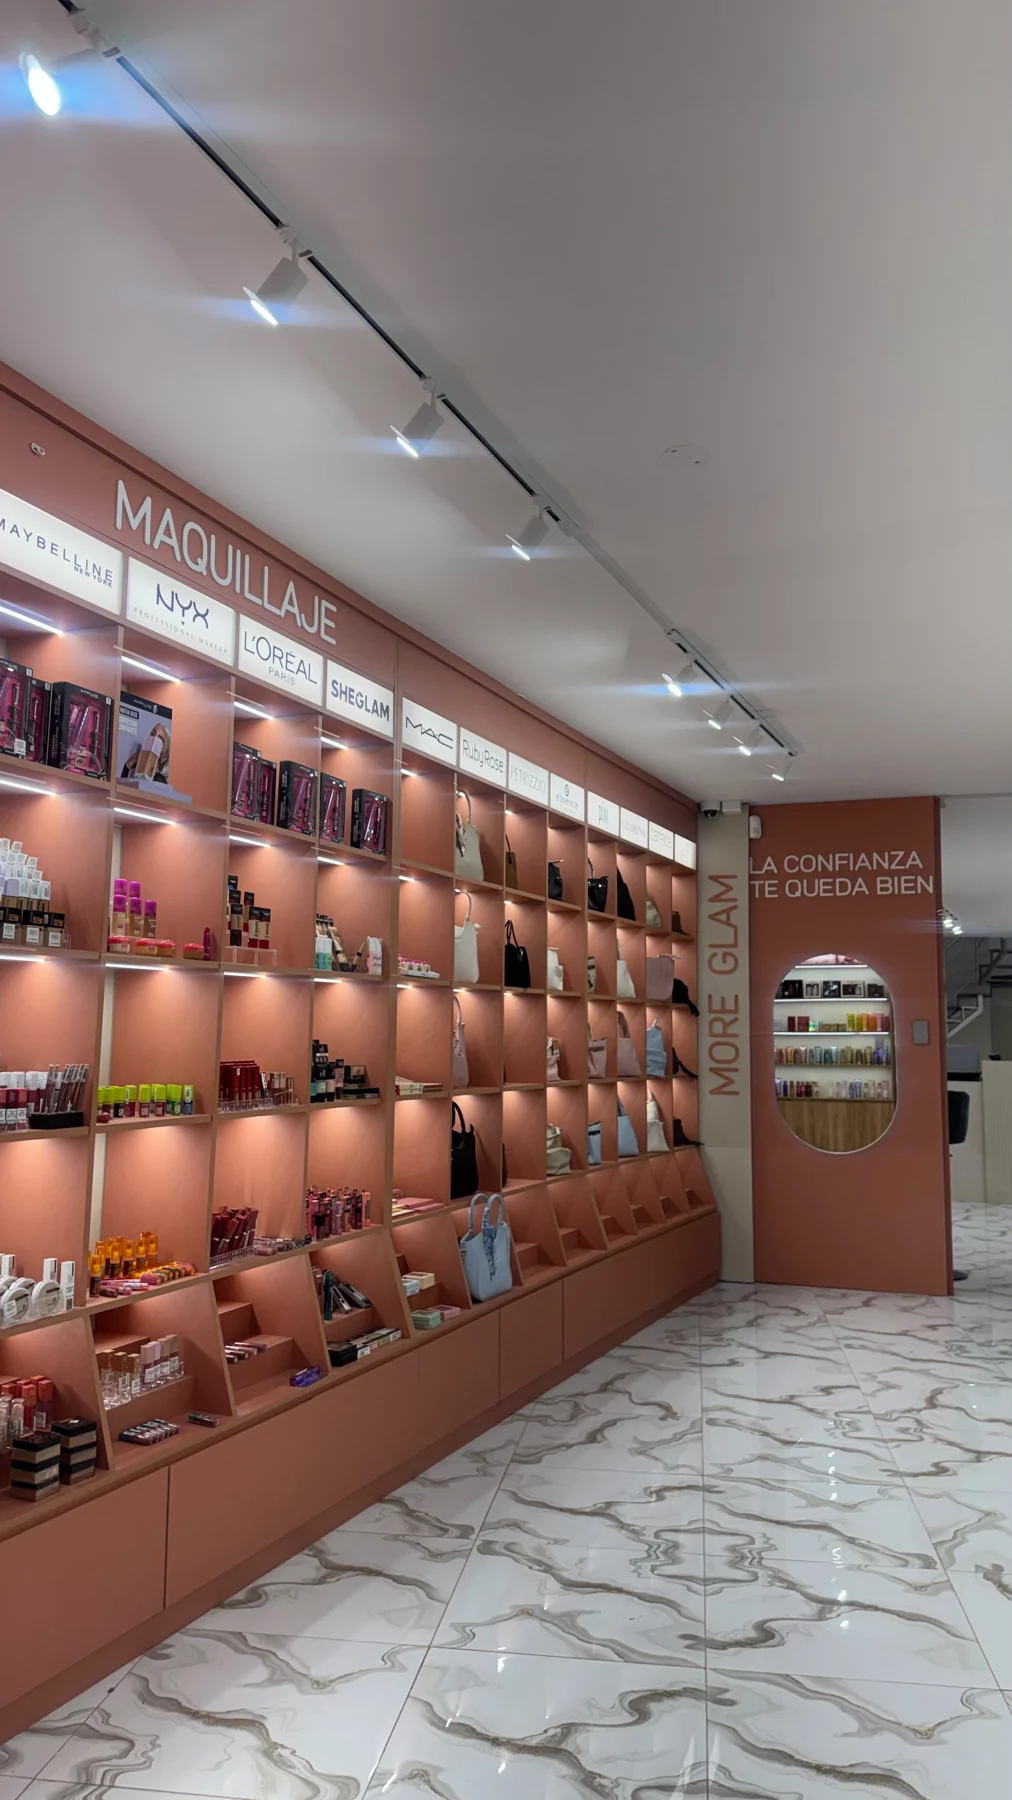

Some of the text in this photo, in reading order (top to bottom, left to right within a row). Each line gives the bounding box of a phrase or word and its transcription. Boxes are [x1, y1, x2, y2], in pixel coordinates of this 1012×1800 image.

[74, 566, 113, 589] NEW YORK
[115, 479, 338, 645] MAQUILLAJE
[156, 583, 209, 629] NYX
[133, 606, 229, 655] PROFESSIONAL MAKEUP
[244, 631, 318, 685] L'ORÉAL
[331, 679, 390, 722] SHEGLAM
[510, 765, 547, 794] PETRIZZIO
[556, 793, 579, 810] essence
[750, 850, 923, 875] LA CONFIANZA
[750, 875, 934, 899] TE QUEDA BIEN
[708, 874, 741, 1096] MORE GLAM
